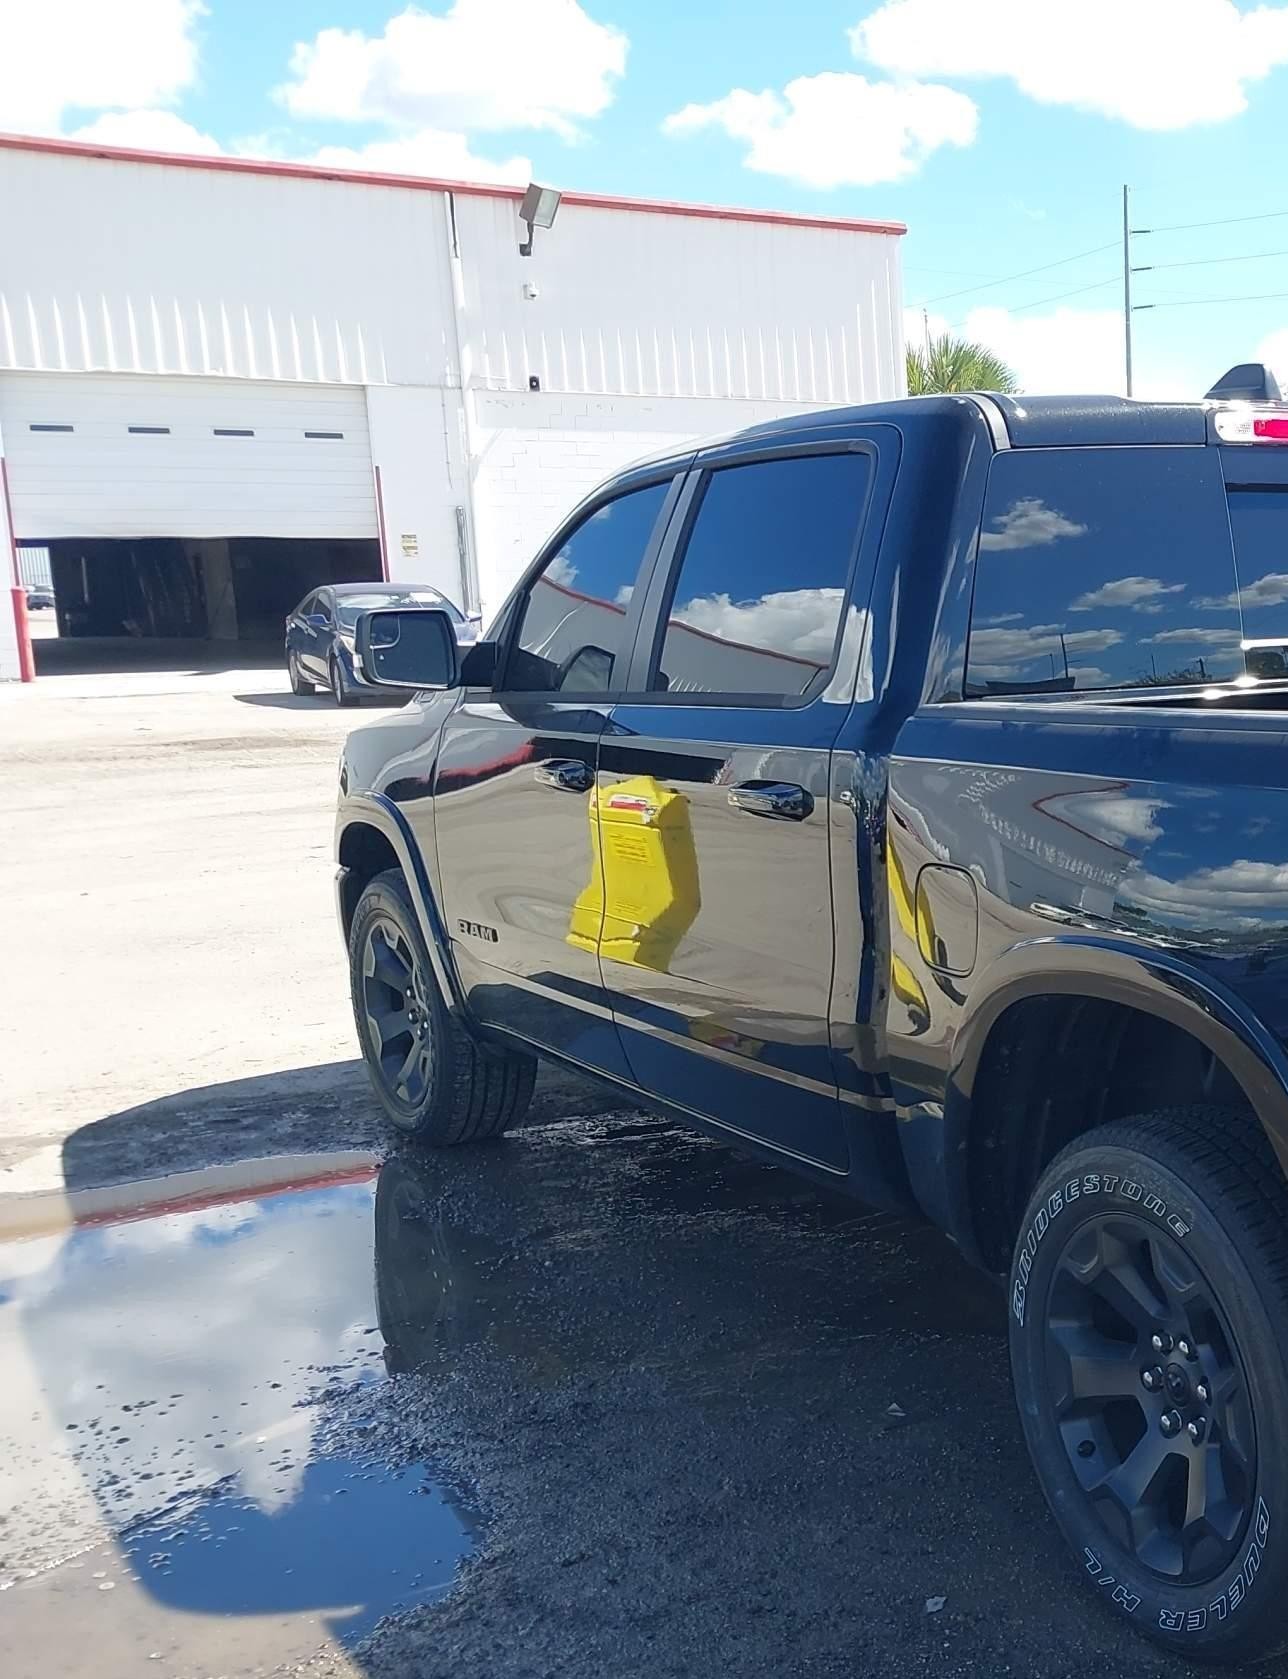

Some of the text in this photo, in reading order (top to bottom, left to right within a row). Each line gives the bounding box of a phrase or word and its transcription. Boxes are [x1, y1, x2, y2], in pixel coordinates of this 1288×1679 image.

[458, 918, 498, 943] RAM
[1013, 1174, 1190, 1327] BRIDGESTONE
[1084, 1496, 1270, 1632] DUELER H/L
